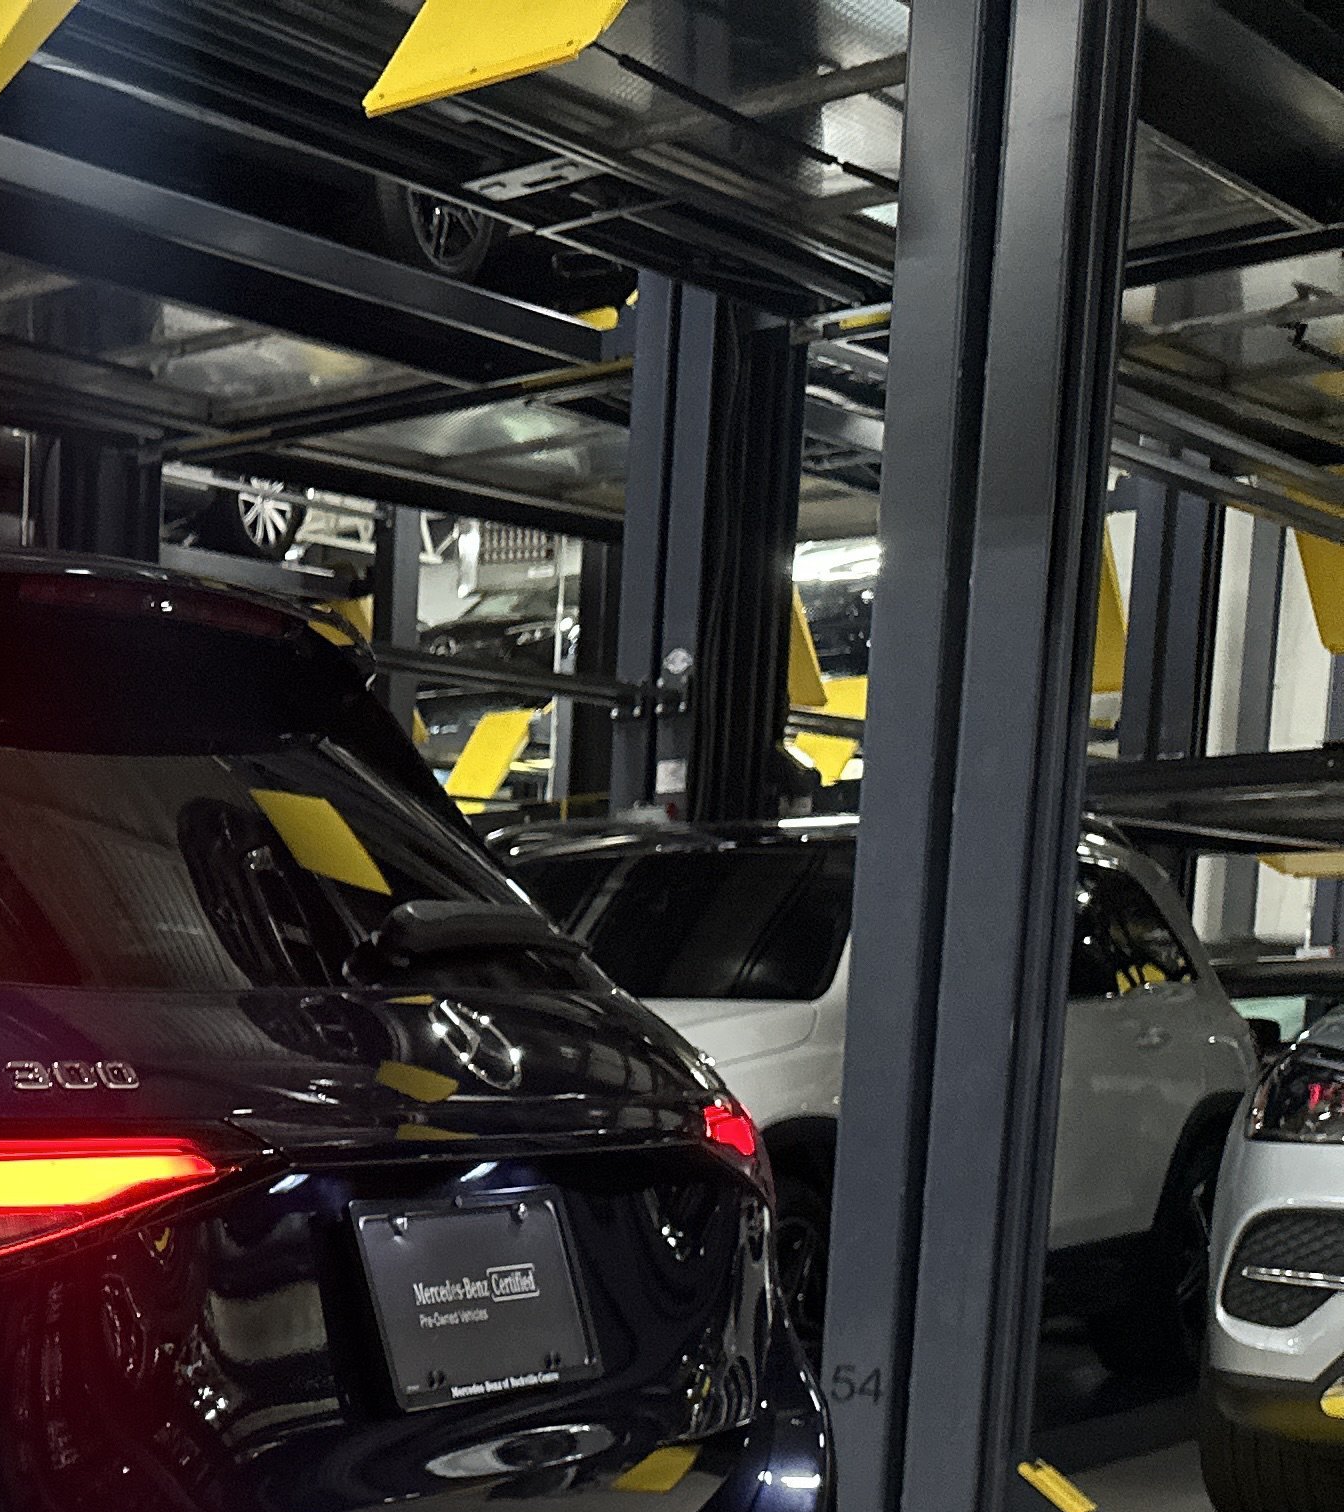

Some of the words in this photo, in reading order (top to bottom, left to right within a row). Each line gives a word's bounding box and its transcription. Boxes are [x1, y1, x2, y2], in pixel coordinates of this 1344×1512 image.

[4, 1060, 140, 1090] 300
[413, 1277, 489, 1305] Mercedes-Benz
[492, 1270, 535, 1295] Certified
[831, 1364, 882, 1404] 54
